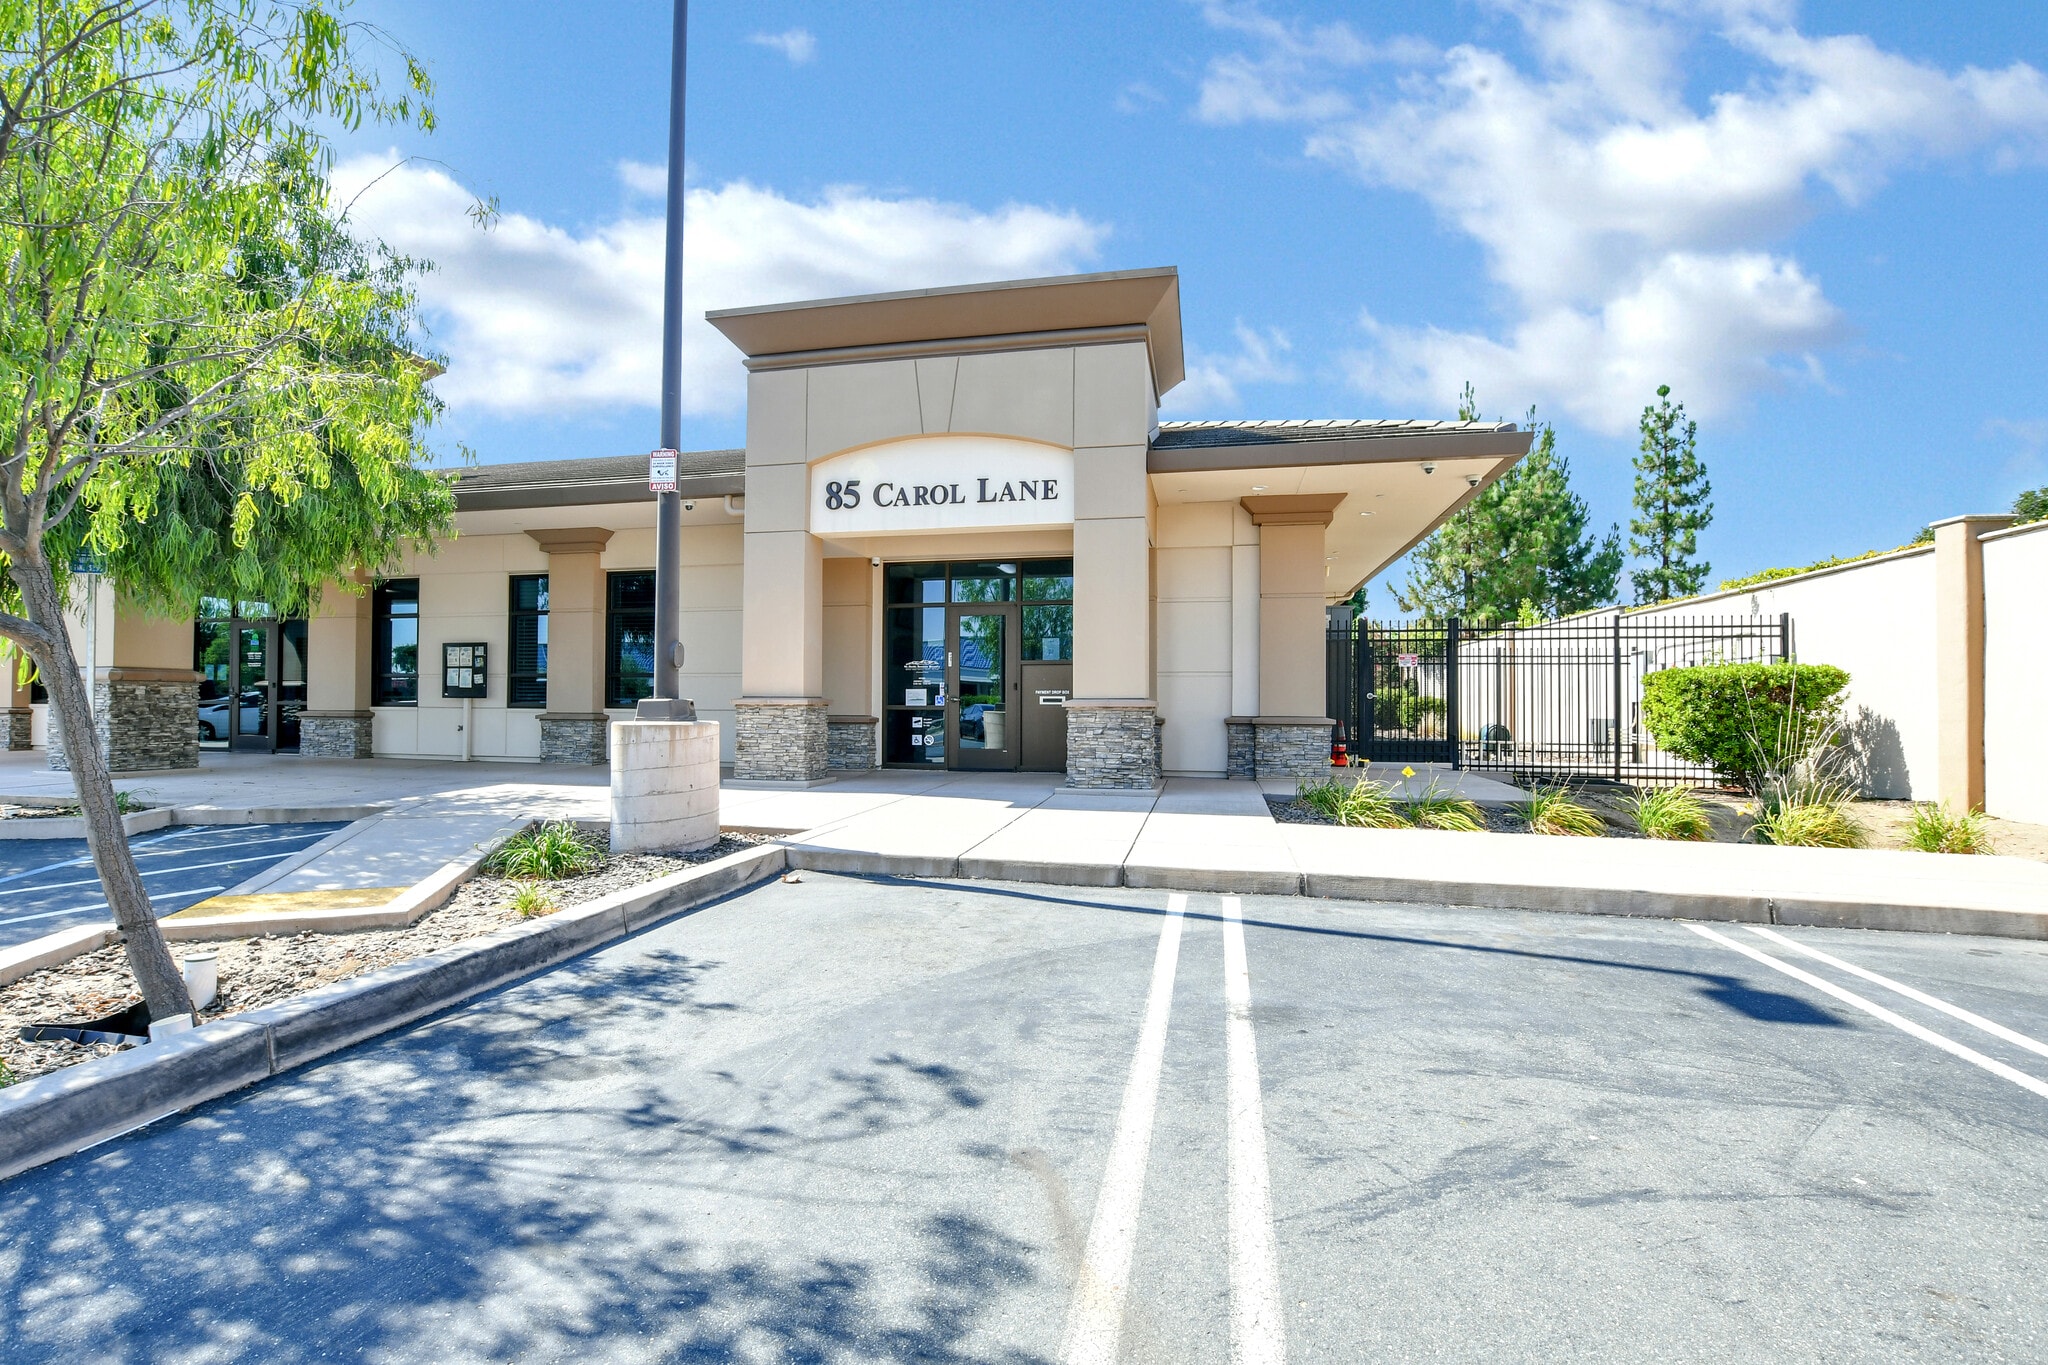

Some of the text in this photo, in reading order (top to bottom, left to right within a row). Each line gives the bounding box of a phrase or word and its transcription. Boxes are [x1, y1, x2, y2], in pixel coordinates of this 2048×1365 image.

[825, 478, 1058, 510] 85 CAROL LANE
